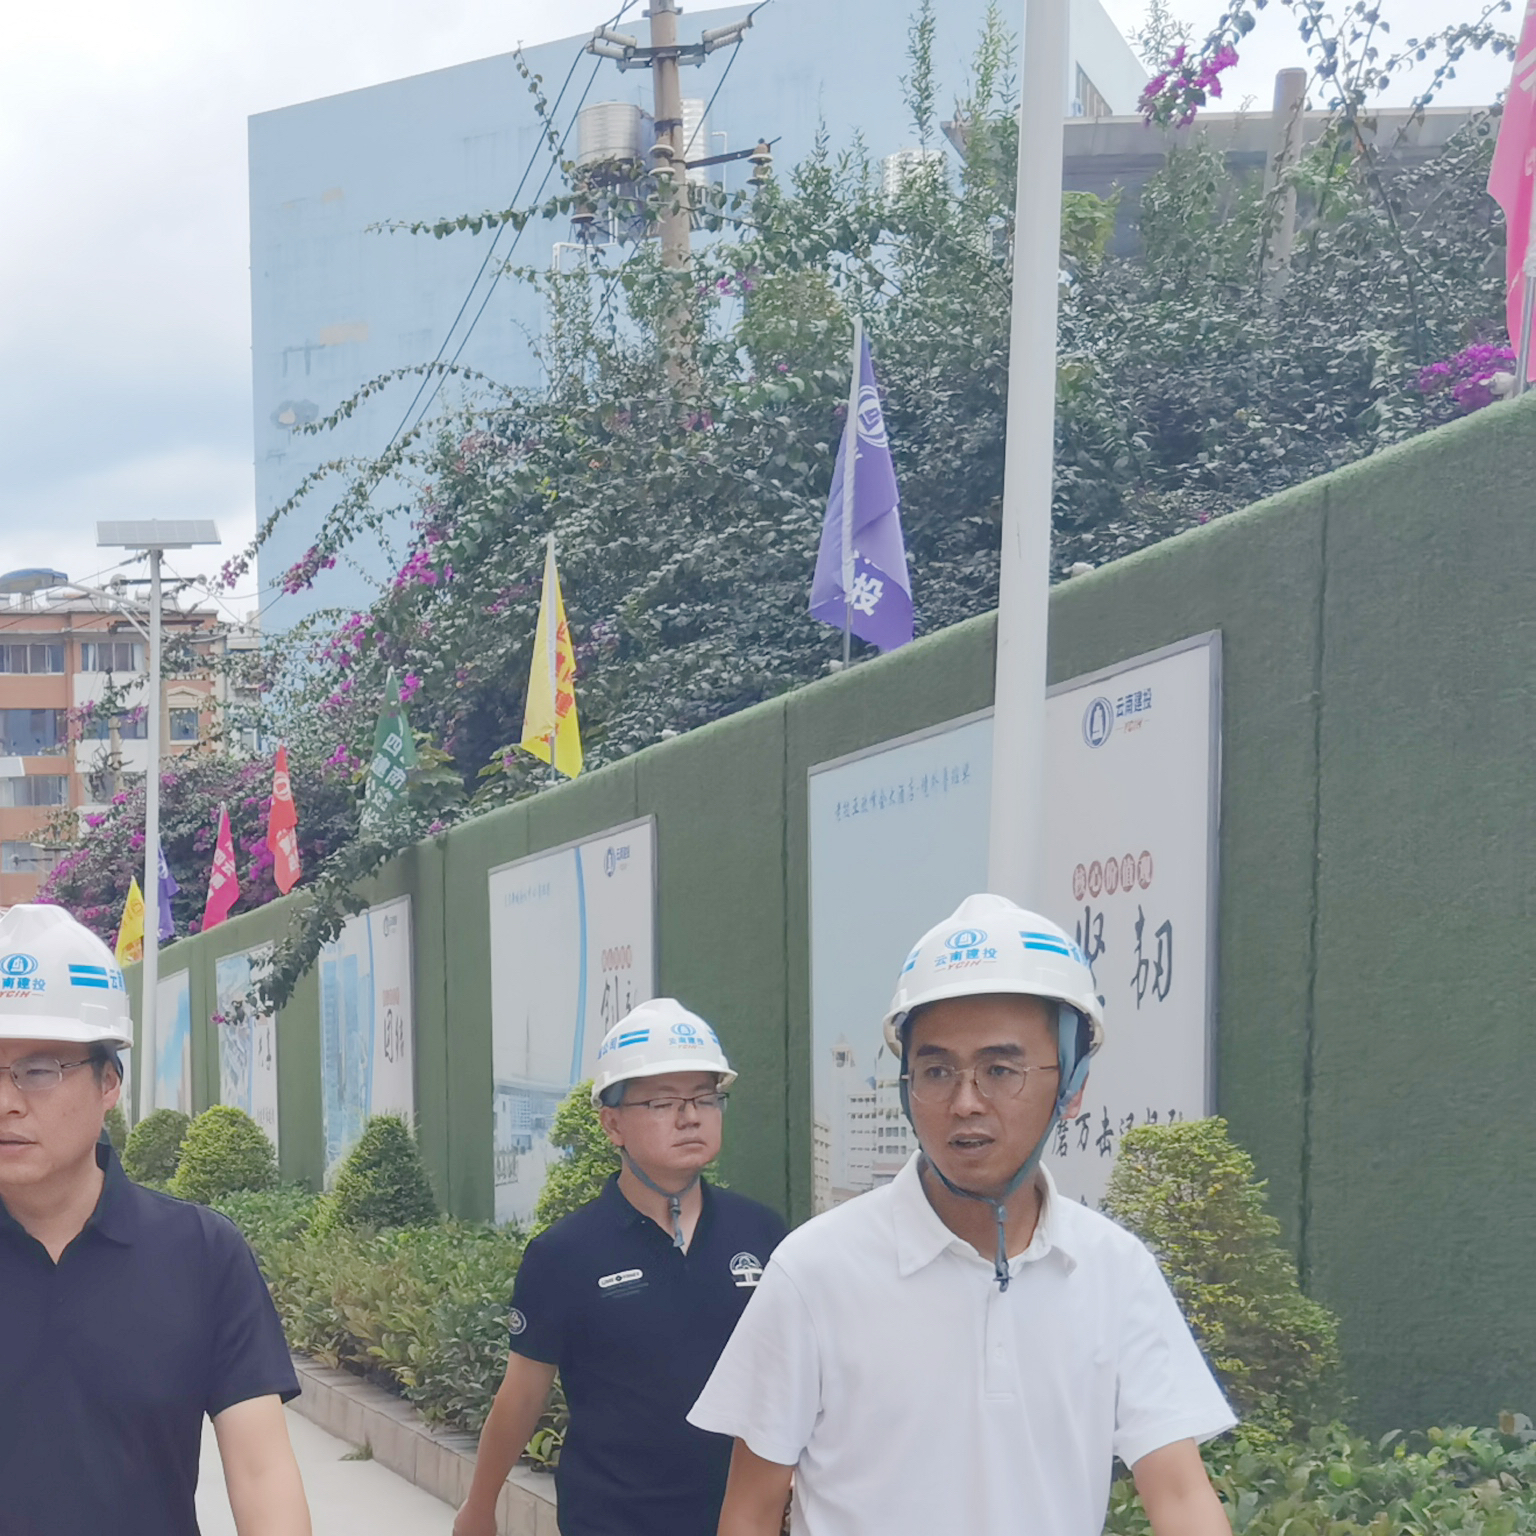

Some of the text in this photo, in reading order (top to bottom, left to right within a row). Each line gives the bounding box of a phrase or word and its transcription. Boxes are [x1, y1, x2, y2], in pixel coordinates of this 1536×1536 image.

[1115, 687, 1152, 718] 云南建投
[1073, 850, 1154, 902] 核心价值观
[934, 947, 999, 968] 云南建投
